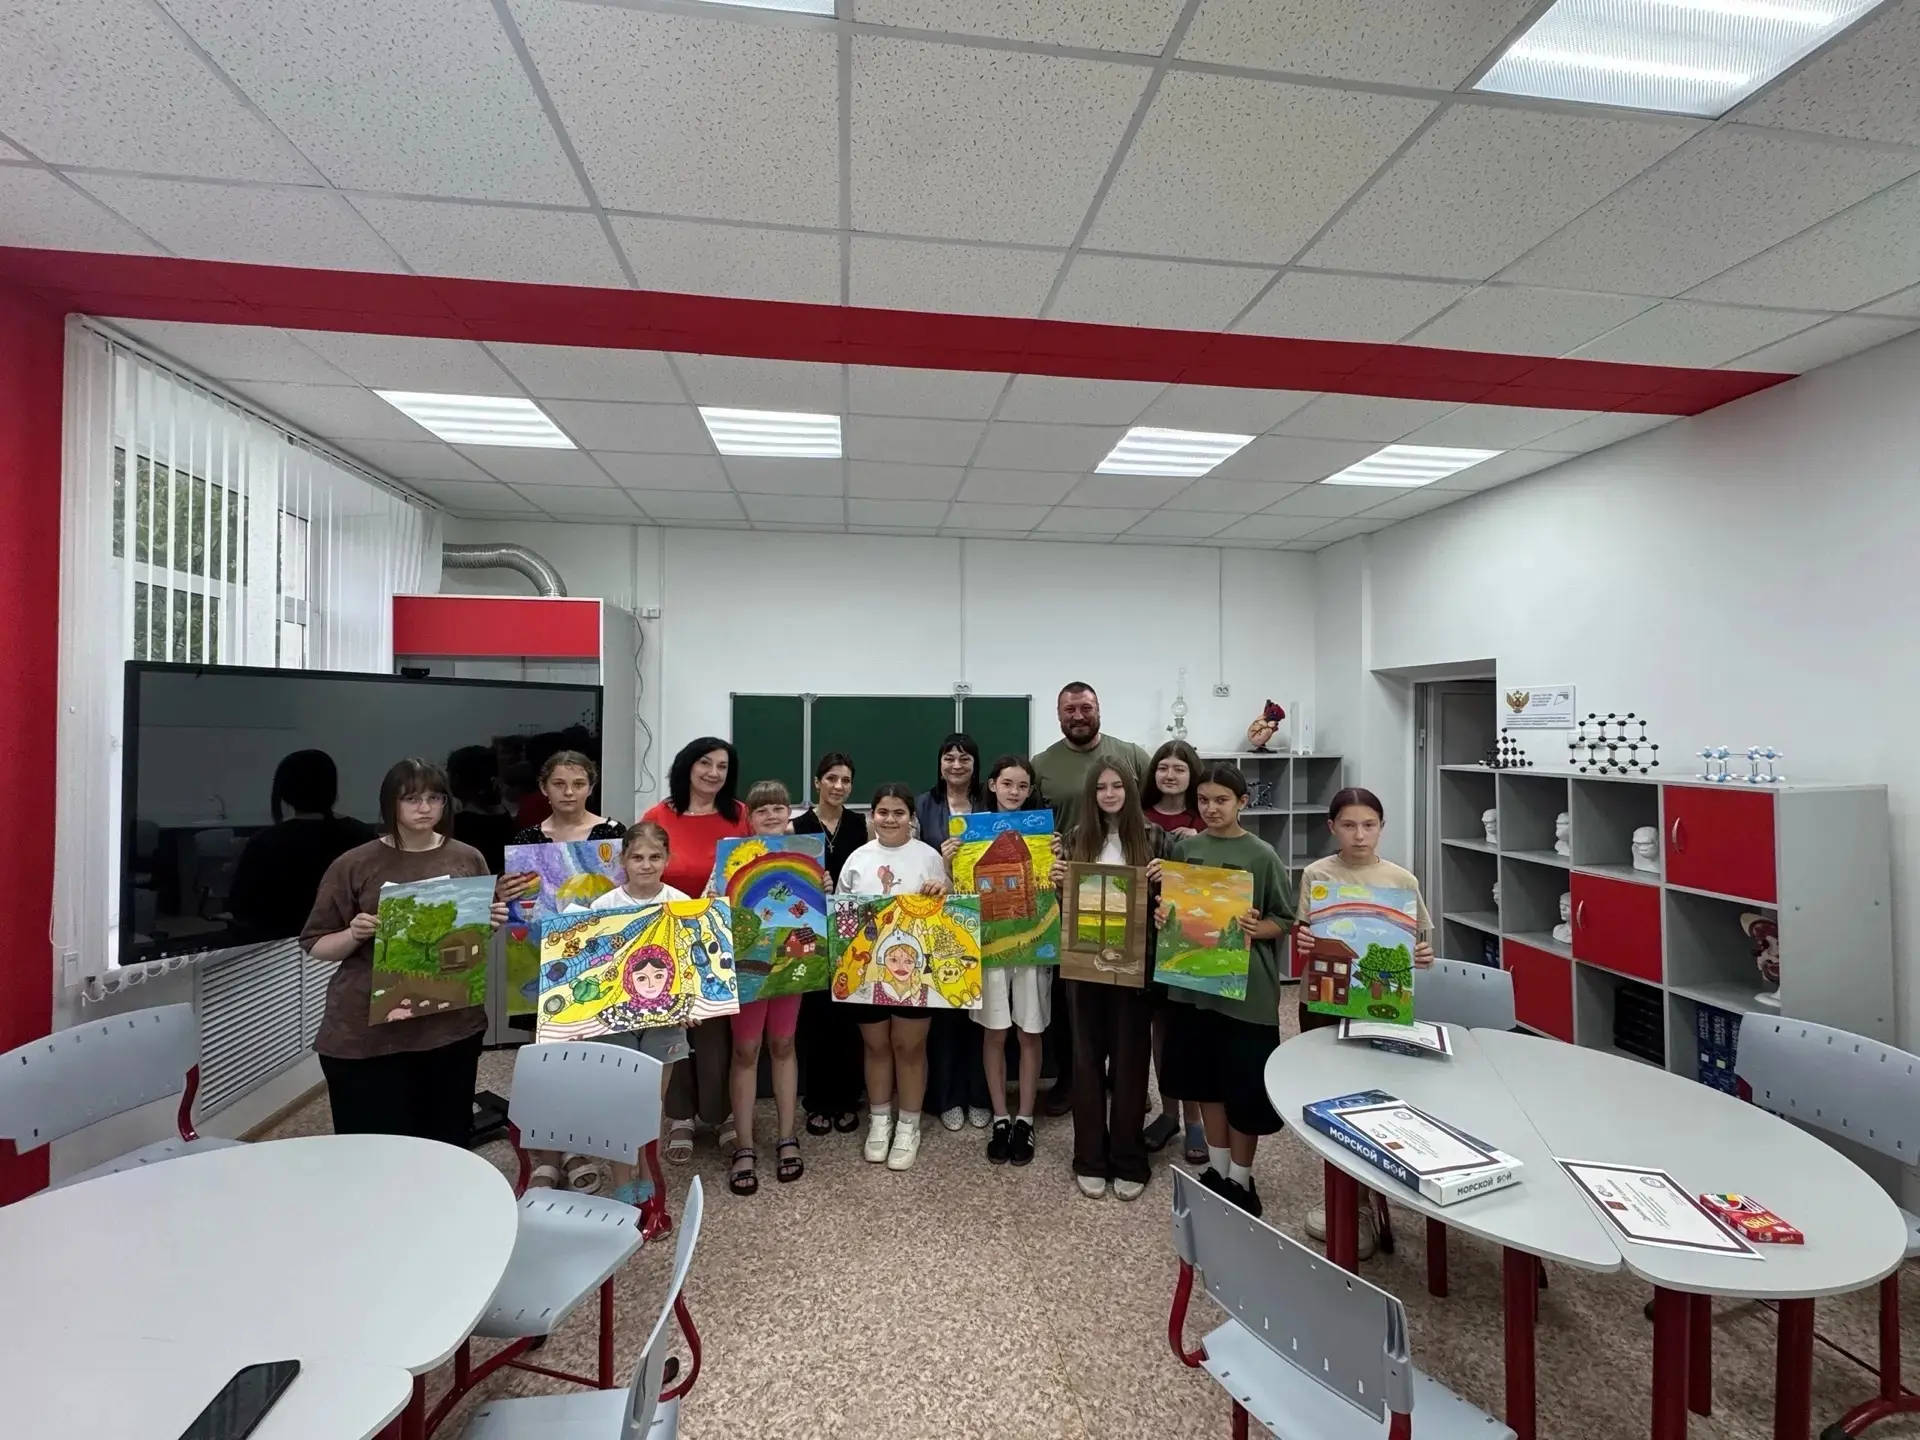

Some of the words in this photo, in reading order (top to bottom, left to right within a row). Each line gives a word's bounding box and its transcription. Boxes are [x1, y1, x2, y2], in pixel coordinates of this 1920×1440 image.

[1329, 1126, 1378, 1163] МОРСКОЙ
[1382, 1158, 1407, 1181] БОЙ
[1457, 1177, 1494, 1196] МОРСКОЙ
[1496, 1171, 1512, 1184] БОЙ
